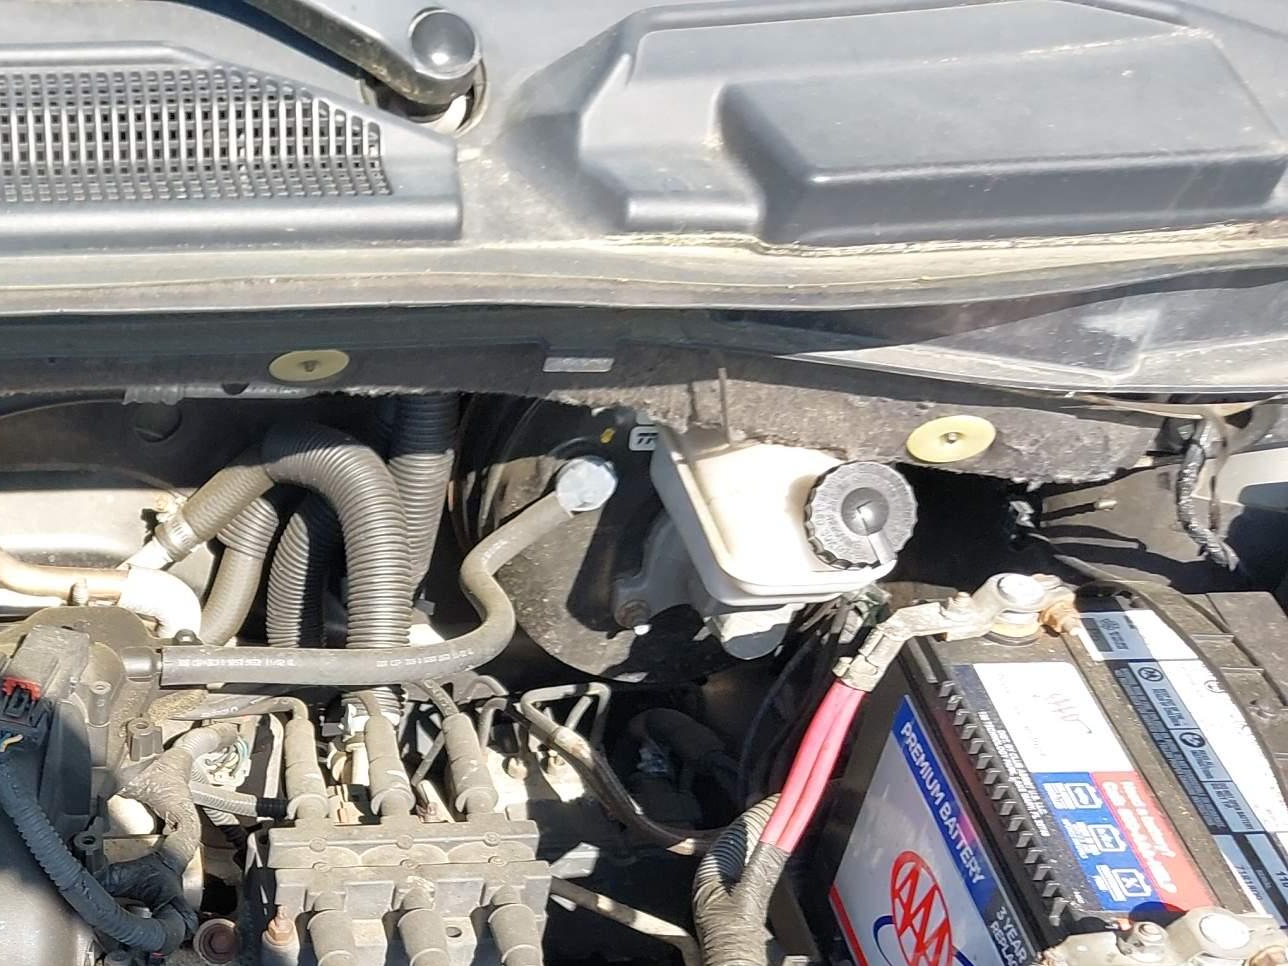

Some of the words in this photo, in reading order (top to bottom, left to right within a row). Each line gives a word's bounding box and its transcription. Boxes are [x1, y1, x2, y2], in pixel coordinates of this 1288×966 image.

[900, 722, 945, 813] PREMIUM
[933, 797, 984, 884] BATTERY
[999, 919, 1027, 964] YEAR
